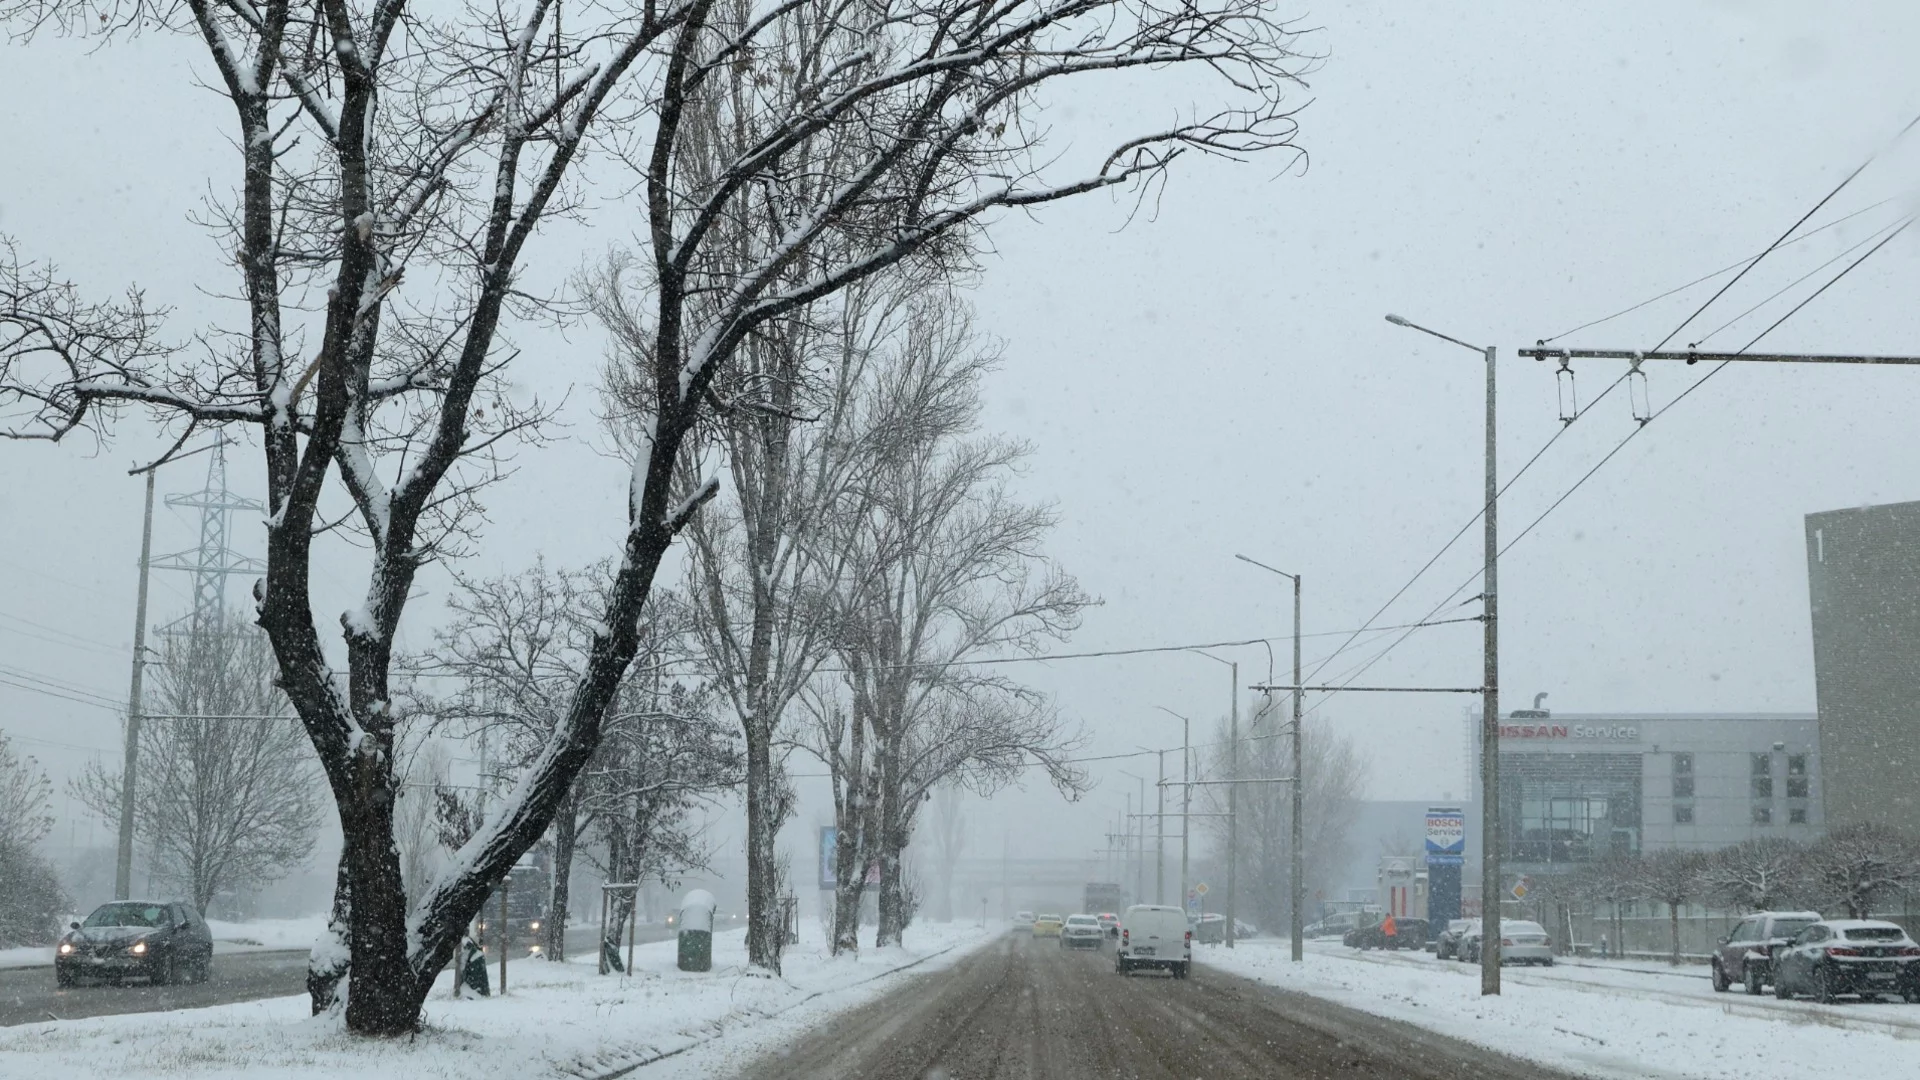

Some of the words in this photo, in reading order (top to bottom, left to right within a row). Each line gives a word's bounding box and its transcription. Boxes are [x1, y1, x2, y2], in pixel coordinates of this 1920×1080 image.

[1498, 724, 1568, 738] ISSAN
[1574, 723, 1637, 738] Service
[1427, 818, 1462, 827] BOSCH
[1427, 827, 1462, 836] Service
